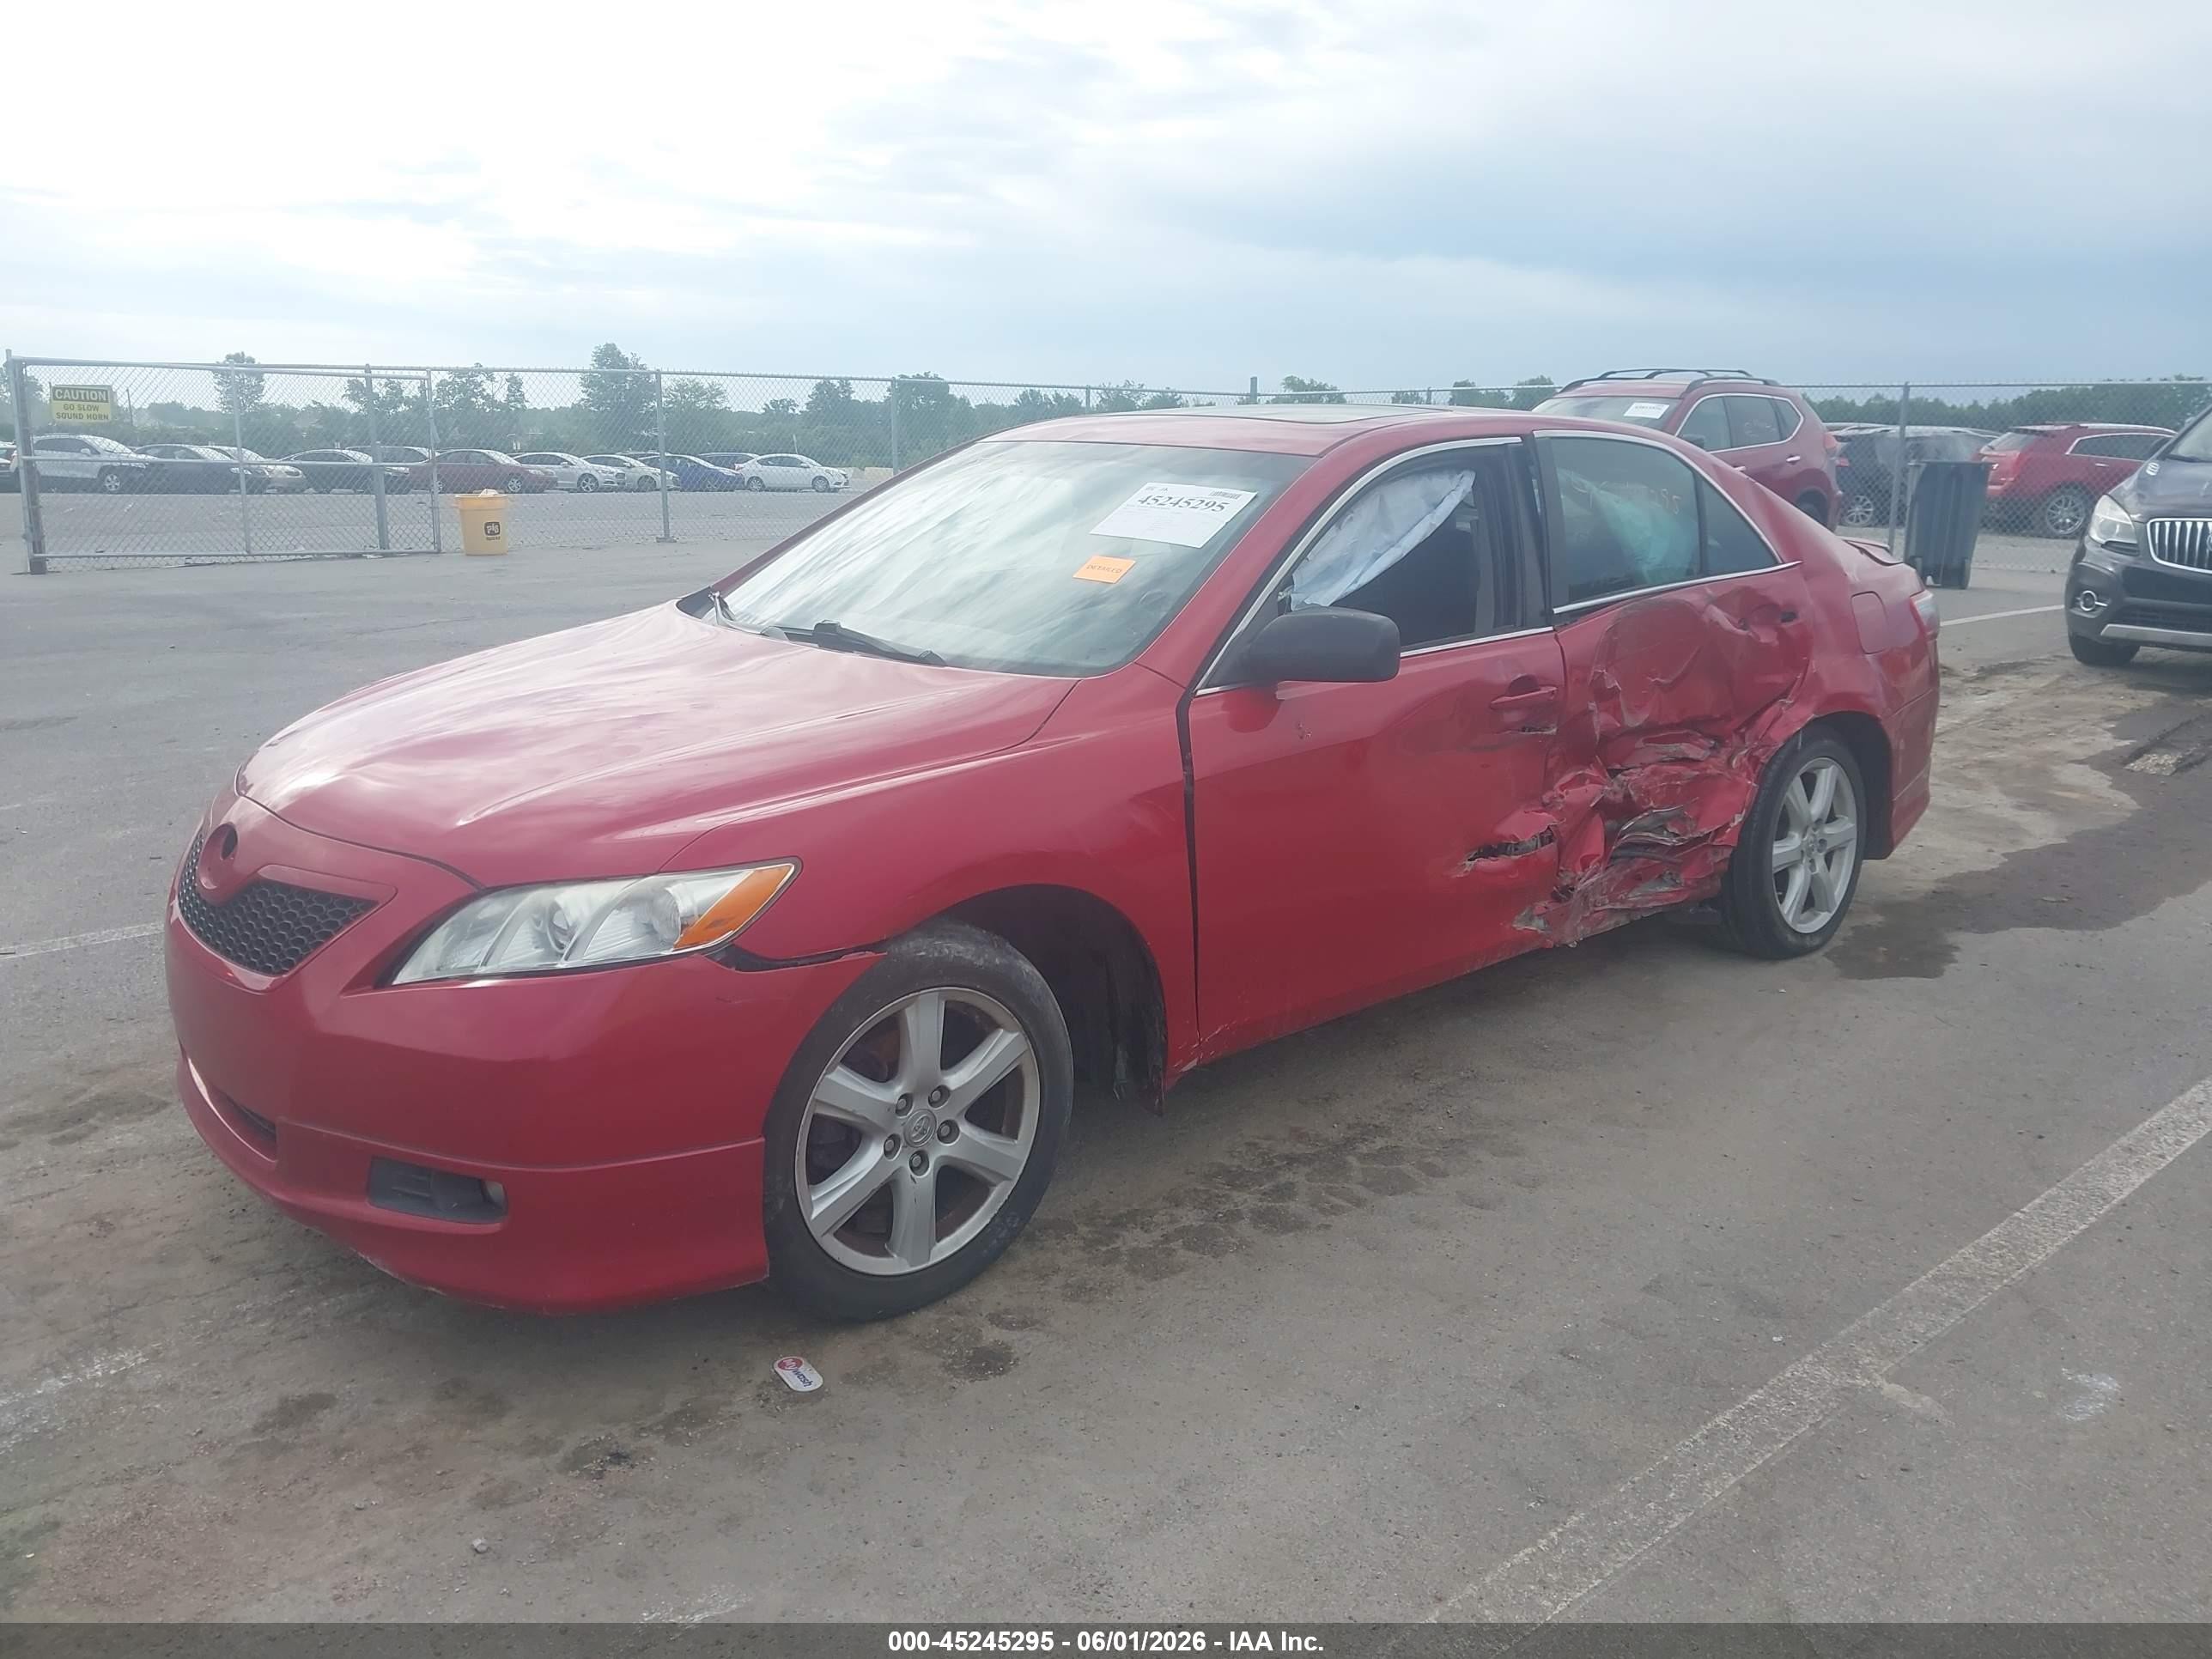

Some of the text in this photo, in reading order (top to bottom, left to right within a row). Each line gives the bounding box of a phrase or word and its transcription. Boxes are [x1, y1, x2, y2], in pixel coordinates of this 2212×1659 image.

[55, 389, 106, 401] CAUTION
[77, 404, 100, 412] SLOW
[1138, 495, 1230, 512] 45245295
